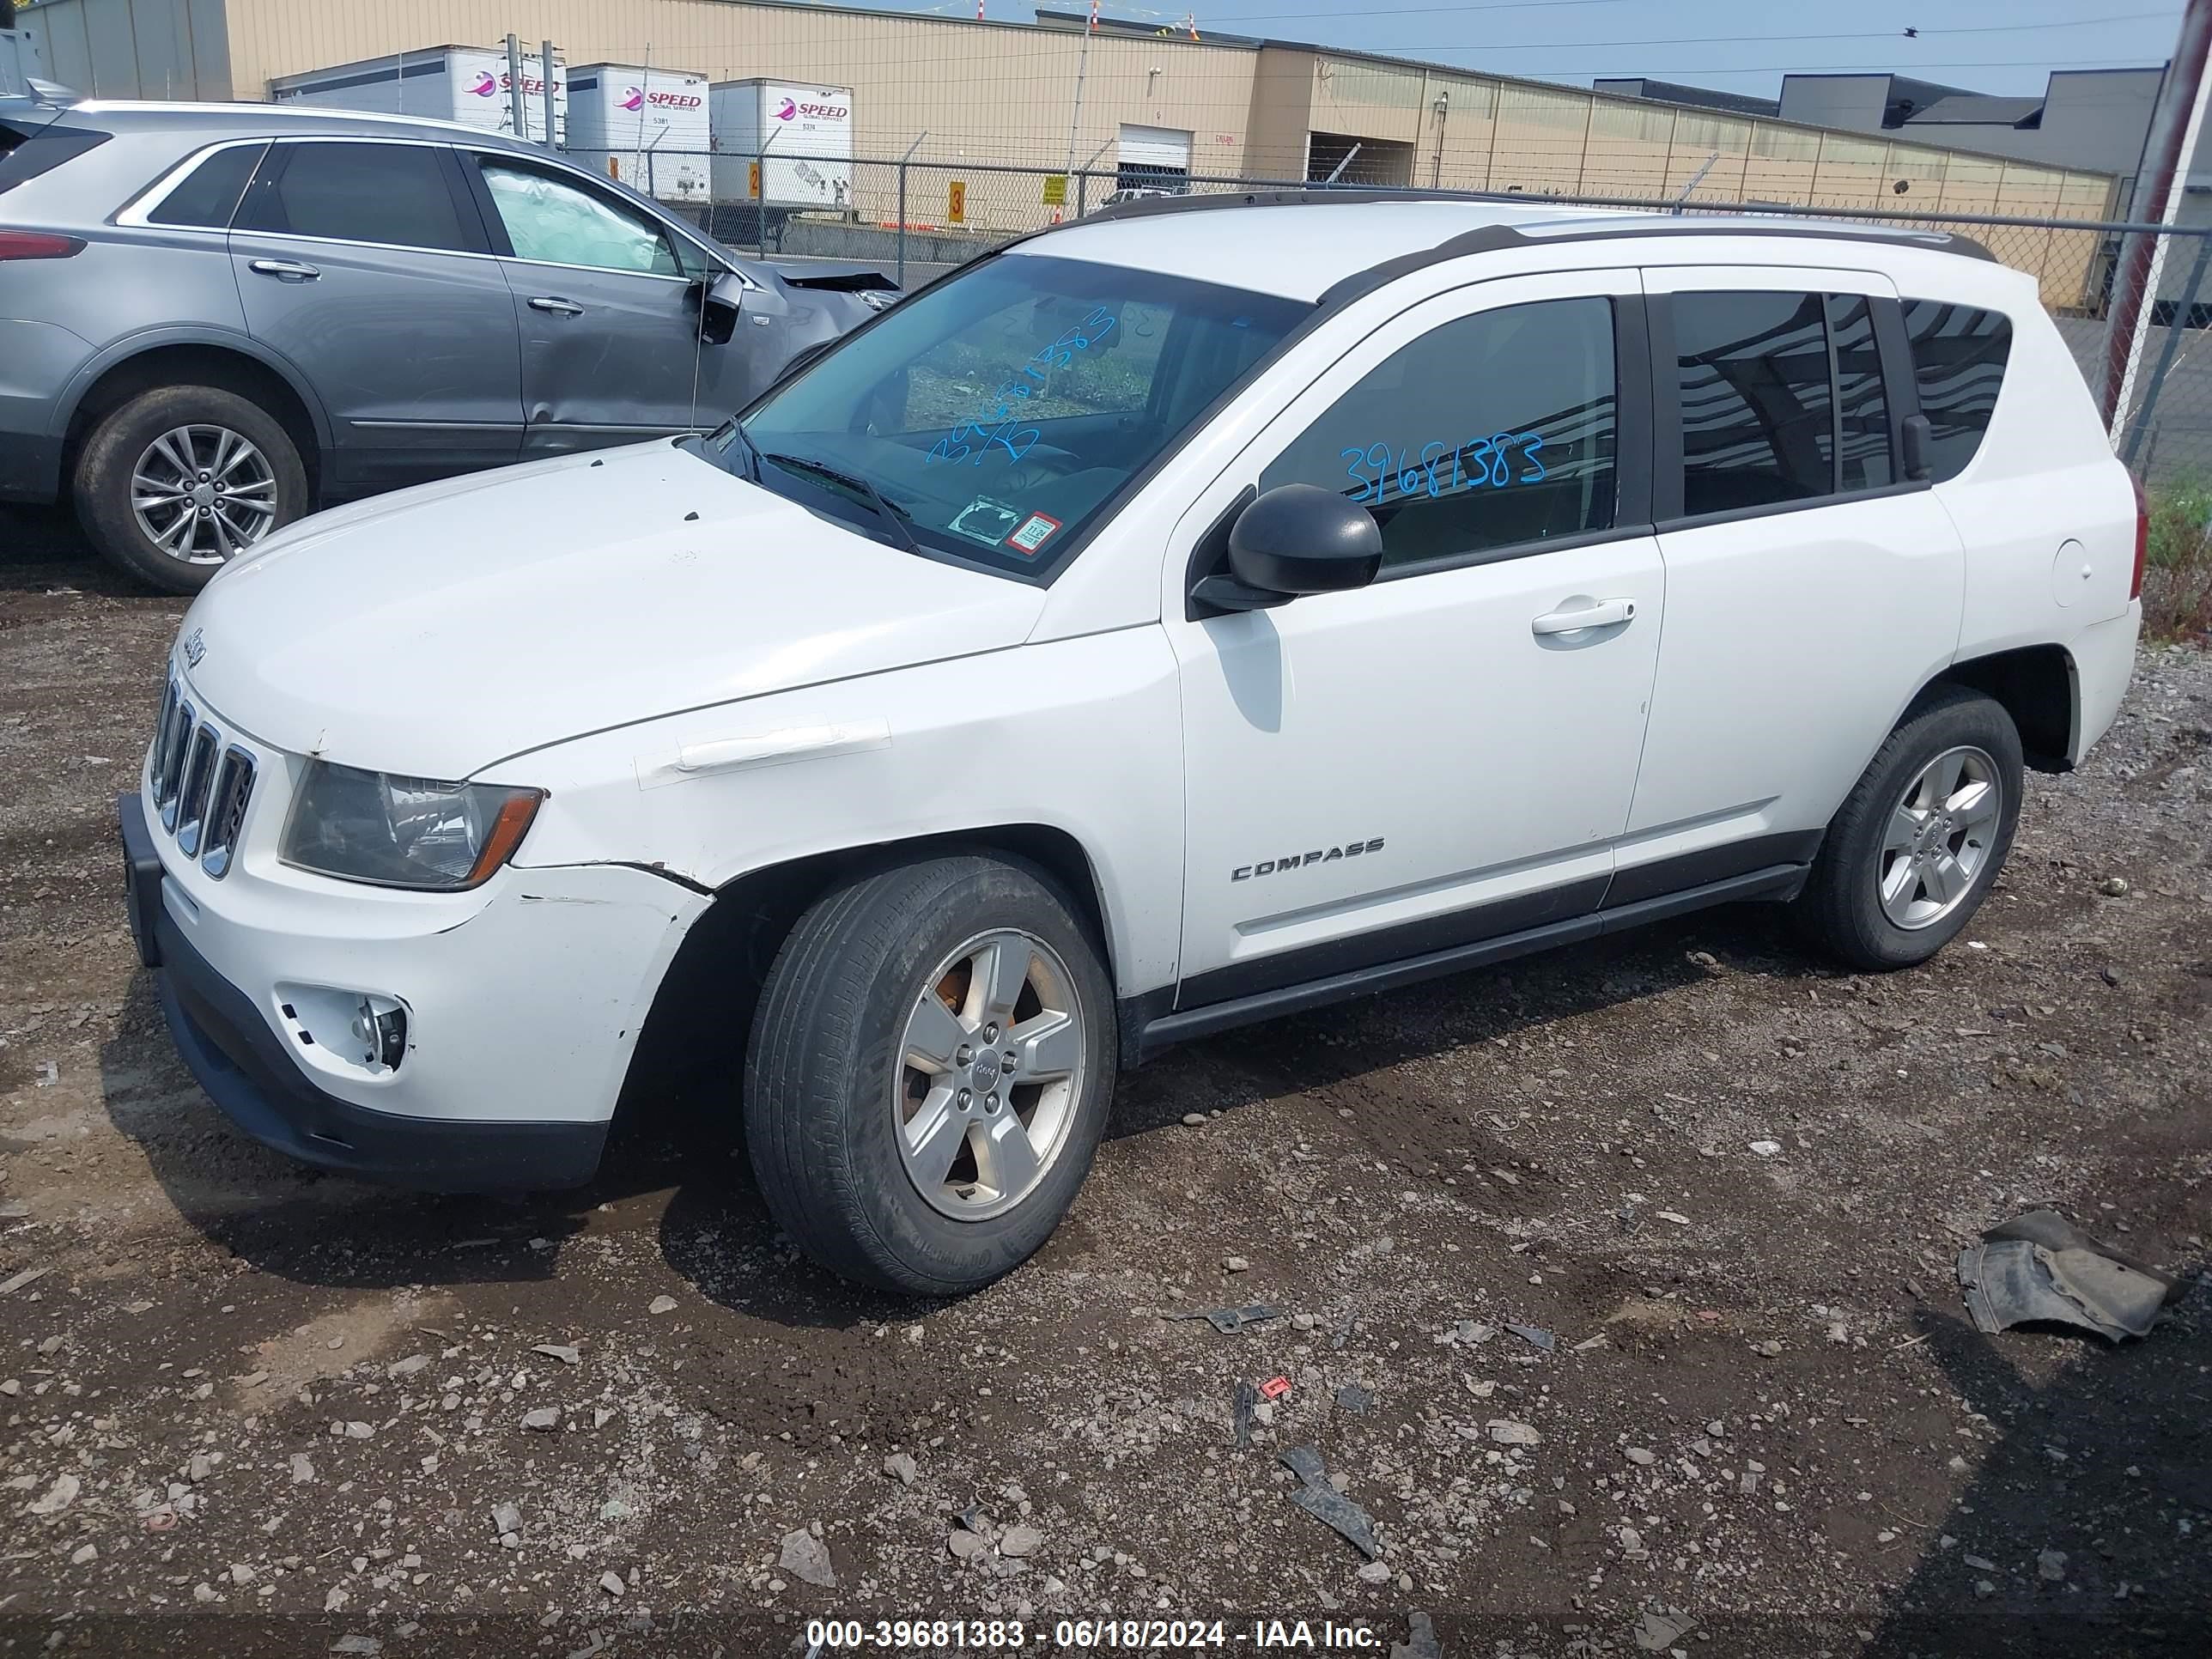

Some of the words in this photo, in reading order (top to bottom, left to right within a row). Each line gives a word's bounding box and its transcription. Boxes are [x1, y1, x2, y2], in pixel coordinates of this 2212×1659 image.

[500, 77, 560, 93] SEE
[647, 92, 702, 107] SPEED
[798, 103, 848, 118] SPEED
[653, 117, 669, 125] 5381
[751, 170, 758, 190] 2
[952, 190, 961, 214] 3
[1340, 433, 1546, 504] 39681383
[1231, 836, 1385, 883] COMPASS
